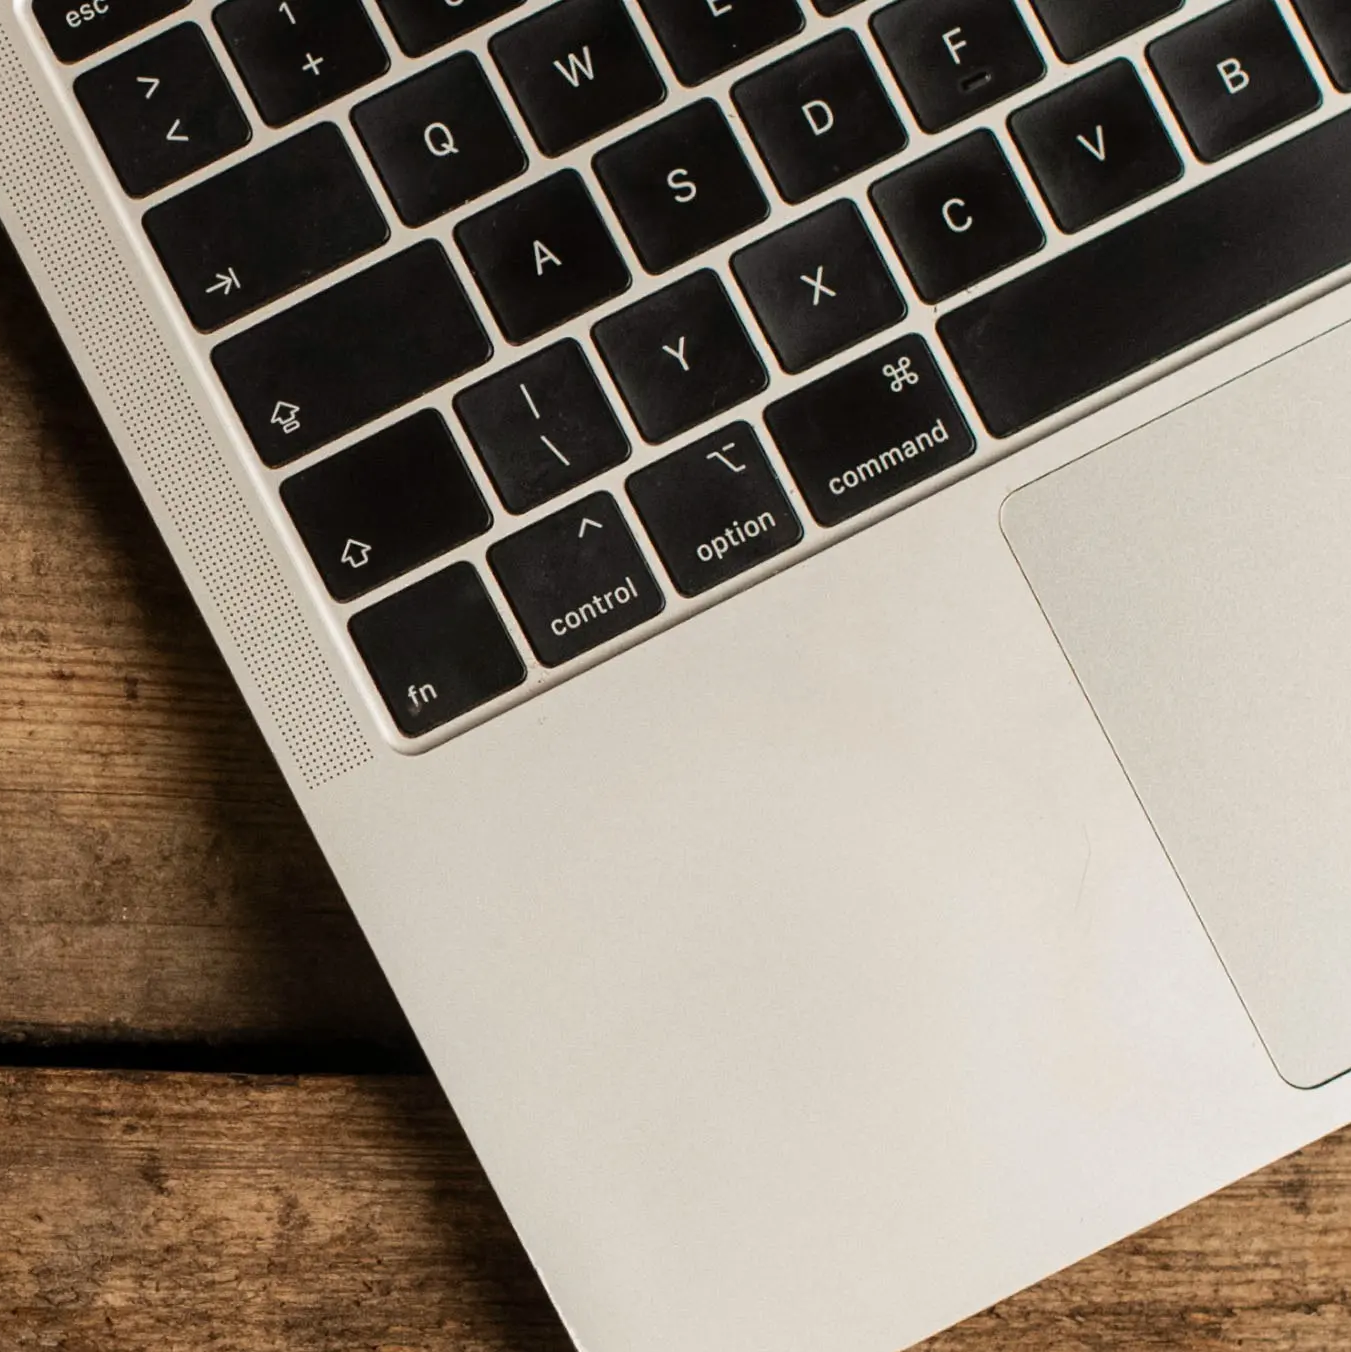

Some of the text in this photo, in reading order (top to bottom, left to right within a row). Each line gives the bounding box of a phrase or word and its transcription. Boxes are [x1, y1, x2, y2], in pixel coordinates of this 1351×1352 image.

[65, 0, 109, 28] esc
[278, 1, 296, 25] 1
[942, 27, 967, 65] F
[553, 46, 594, 87] W
[1216, 57, 1250, 94] B
[801, 100, 834, 136] D
[424, 122, 459, 157] Q
[1076, 125, 1106, 161] V
[667, 168, 697, 203] S
[942, 198, 973, 232] C
[533, 240, 562, 276] A
[800, 265, 837, 306] X
[662, 336, 690, 371] Y
[828, 418, 949, 495] command
[696, 506, 776, 562] option
[550, 576, 638, 636] control
[407, 679, 438, 709] fn
